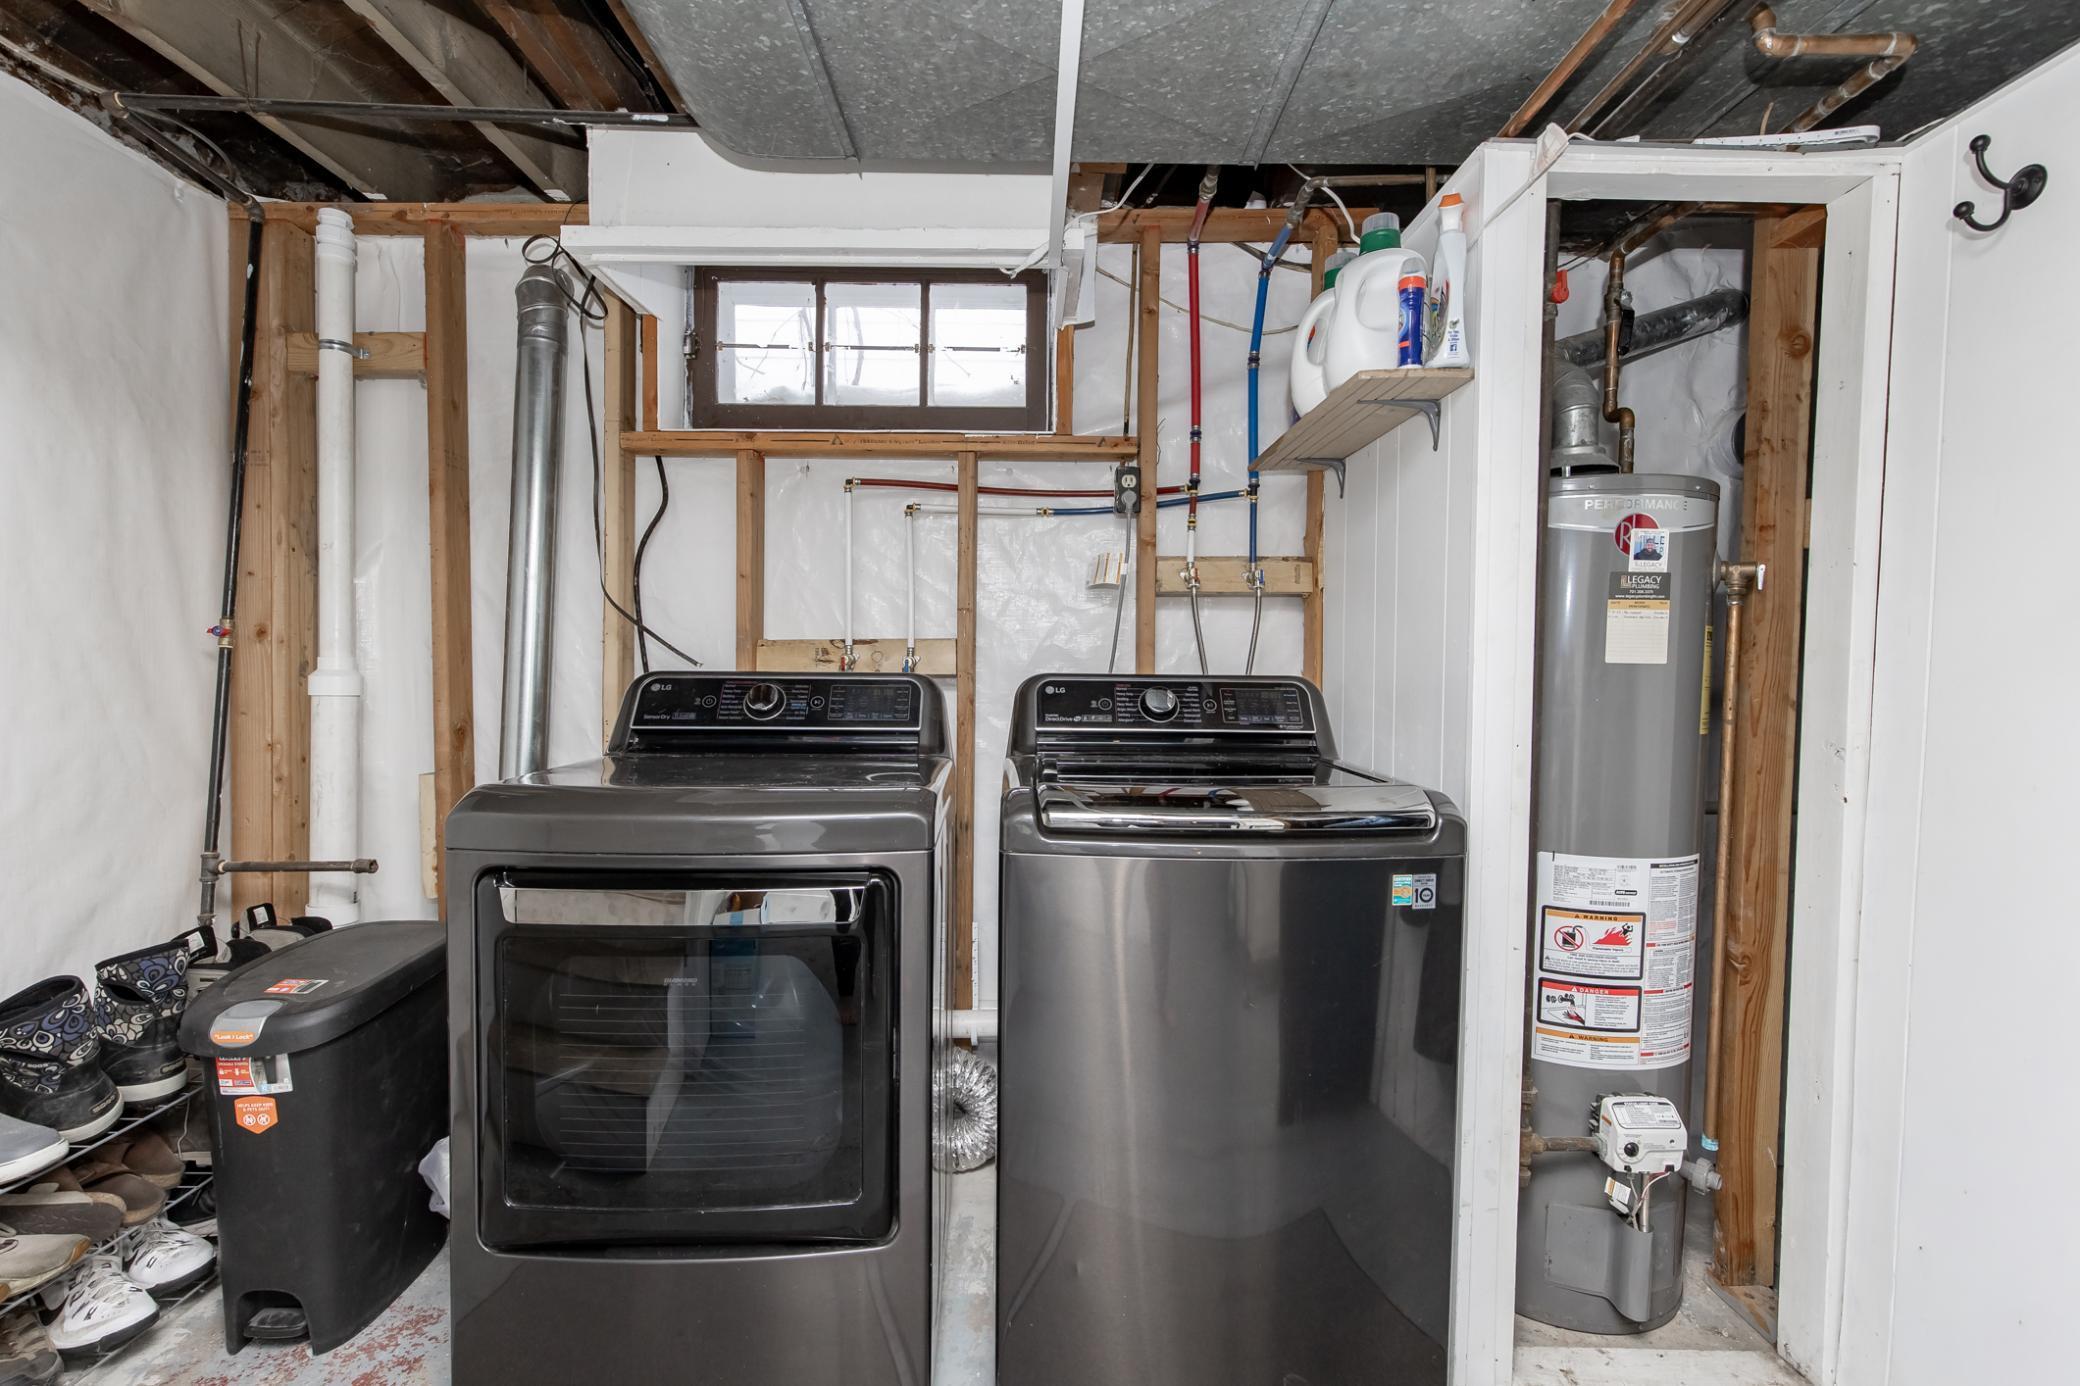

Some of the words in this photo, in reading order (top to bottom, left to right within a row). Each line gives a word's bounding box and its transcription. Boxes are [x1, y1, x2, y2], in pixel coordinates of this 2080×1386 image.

[1584, 499, 1688, 511] PERFORMANCE
[1628, 575, 1662, 584] LEGACY
[1414, 887, 1434, 903] 10
[1583, 914, 1619, 922] WARNING
[1579, 987, 1609, 995] DANGER
[1578, 1034, 1609, 1042] WARNING
